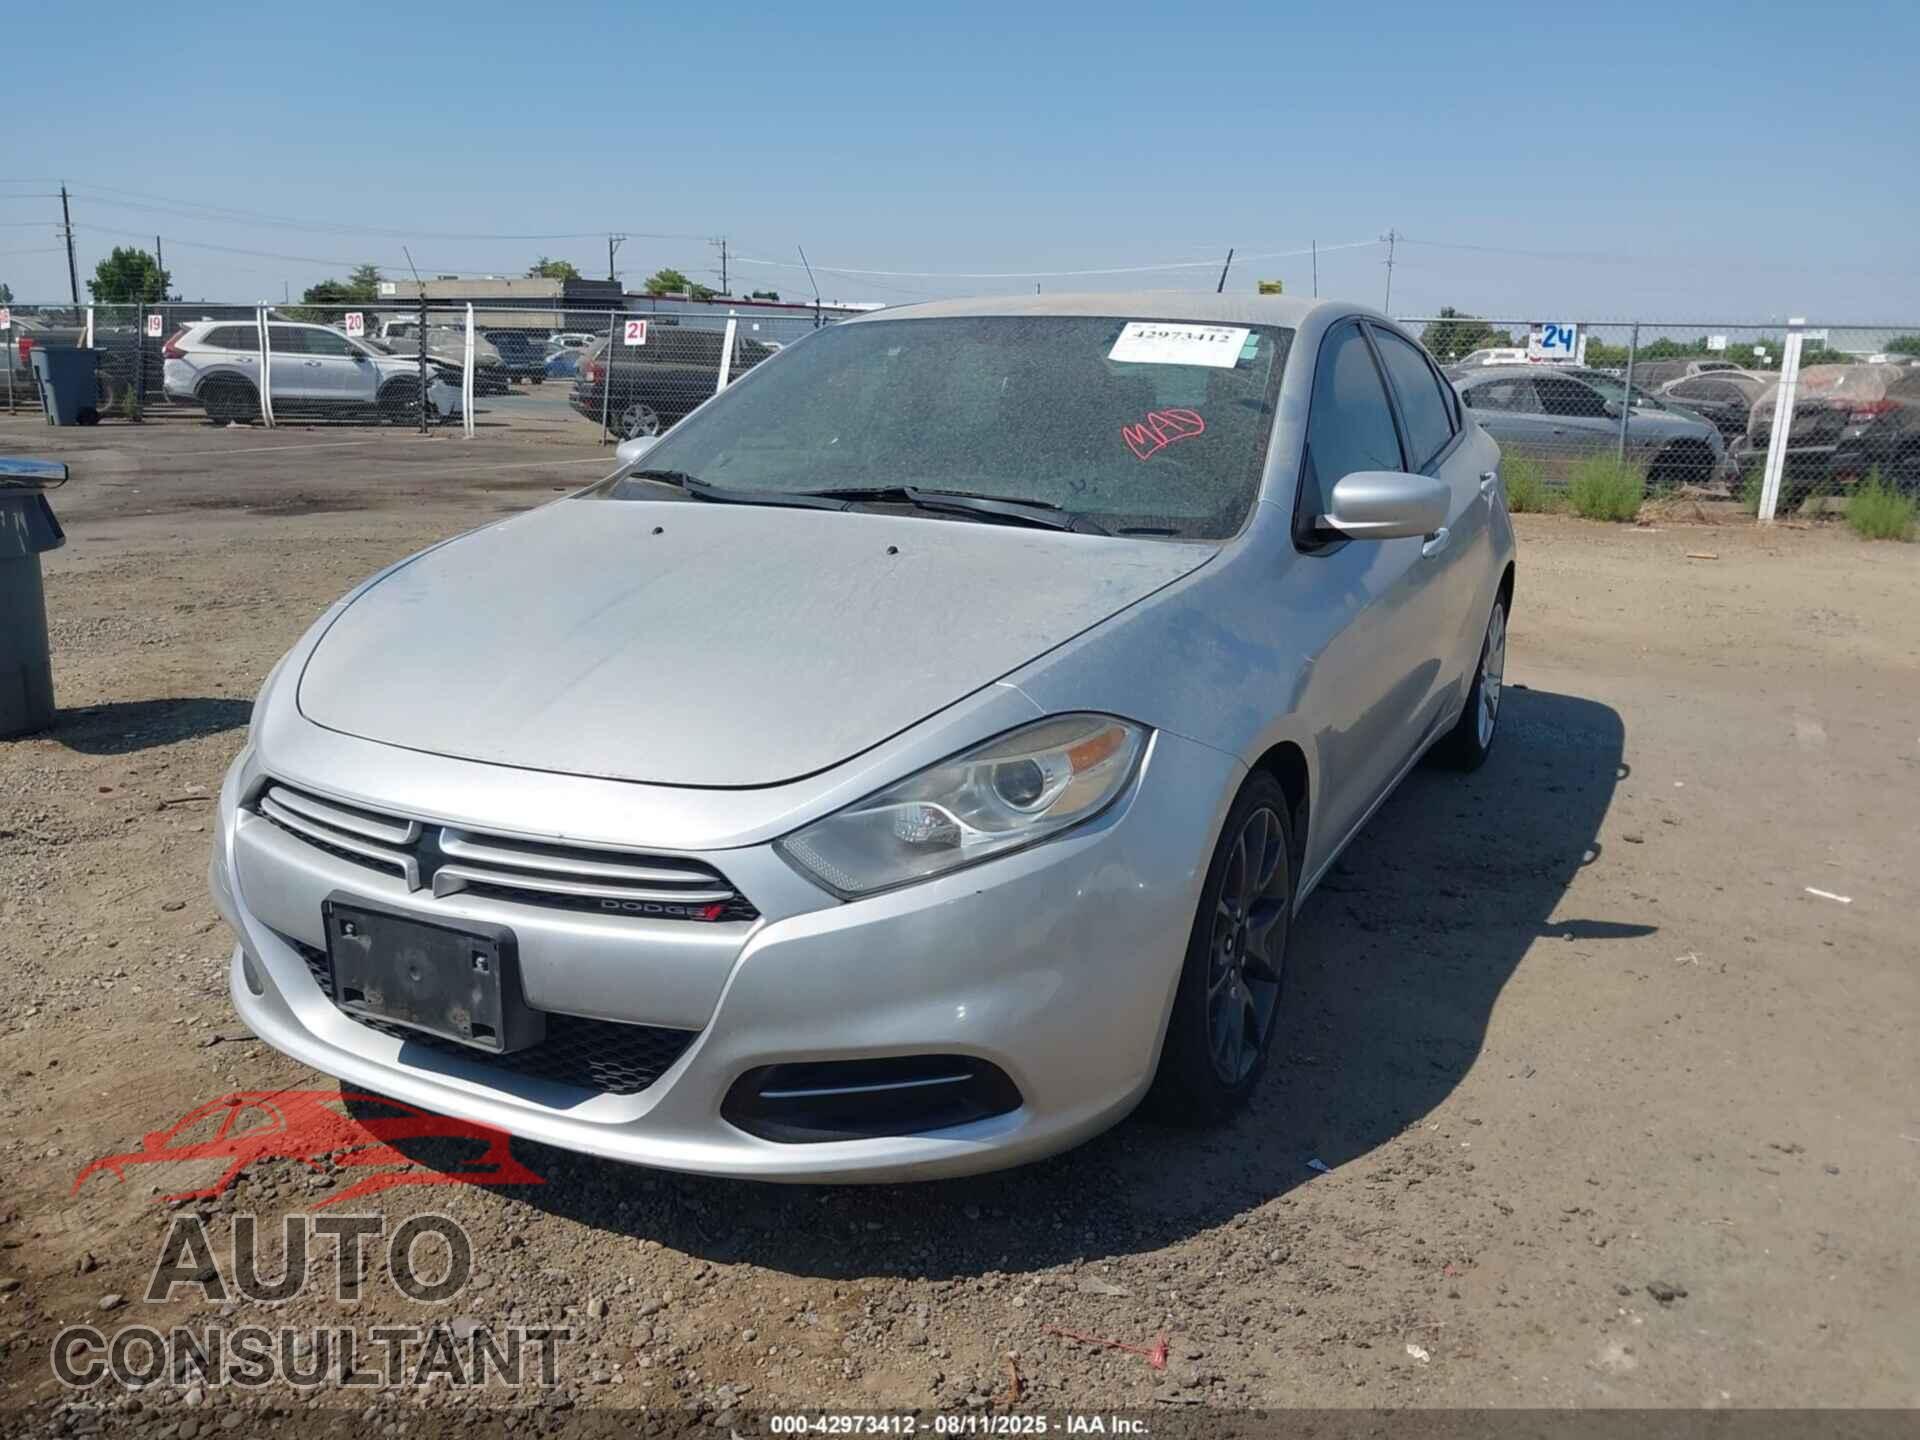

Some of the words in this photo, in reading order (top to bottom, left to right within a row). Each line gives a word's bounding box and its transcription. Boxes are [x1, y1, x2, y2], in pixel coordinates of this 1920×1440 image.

[150, 316, 160, 331] 19
[347, 315, 361, 330] 20
[627, 322, 644, 339] 21
[1133, 330, 1230, 343] 42973412
[1541, 324, 1573, 352] 24
[600, 898, 707, 920] DODGE
